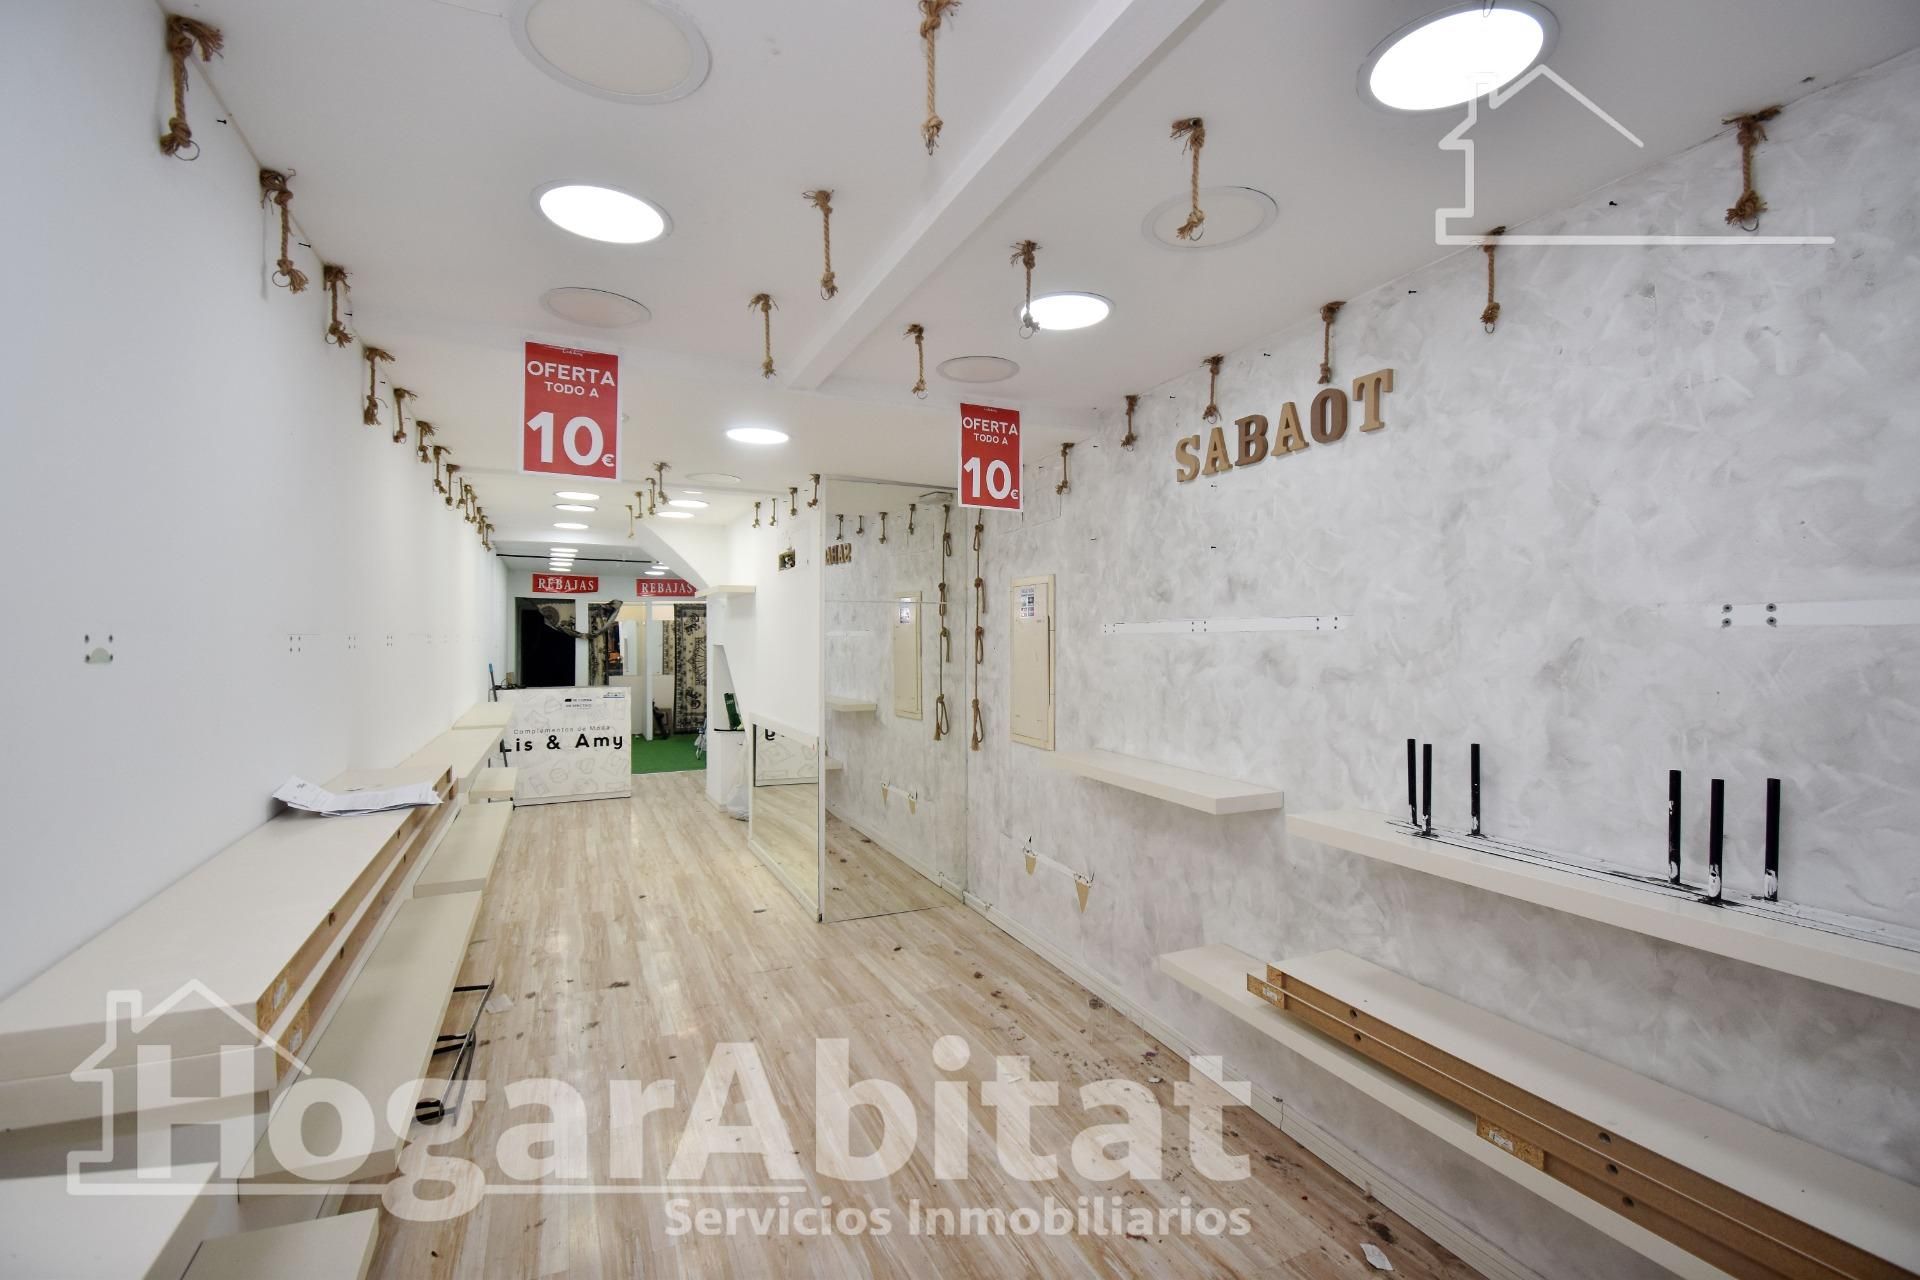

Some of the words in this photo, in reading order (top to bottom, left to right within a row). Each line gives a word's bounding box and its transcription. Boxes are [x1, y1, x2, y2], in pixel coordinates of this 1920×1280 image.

[527, 360, 616, 387] OFERTA
[544, 381, 585, 396] TODO
[589, 387, 599, 398] A
[962, 416, 1019, 436] OFERTA
[1175, 368, 1394, 483] SABAOT
[973, 432, 999, 444] TODO
[1001, 436, 1009, 445] A
[537, 577, 595, 592] REBAJAS
[641, 582, 693, 594] REBAJAS
[499, 737, 533, 753] Lis
[546, 734, 561, 750] &
[574, 733, 624, 750] Amy
